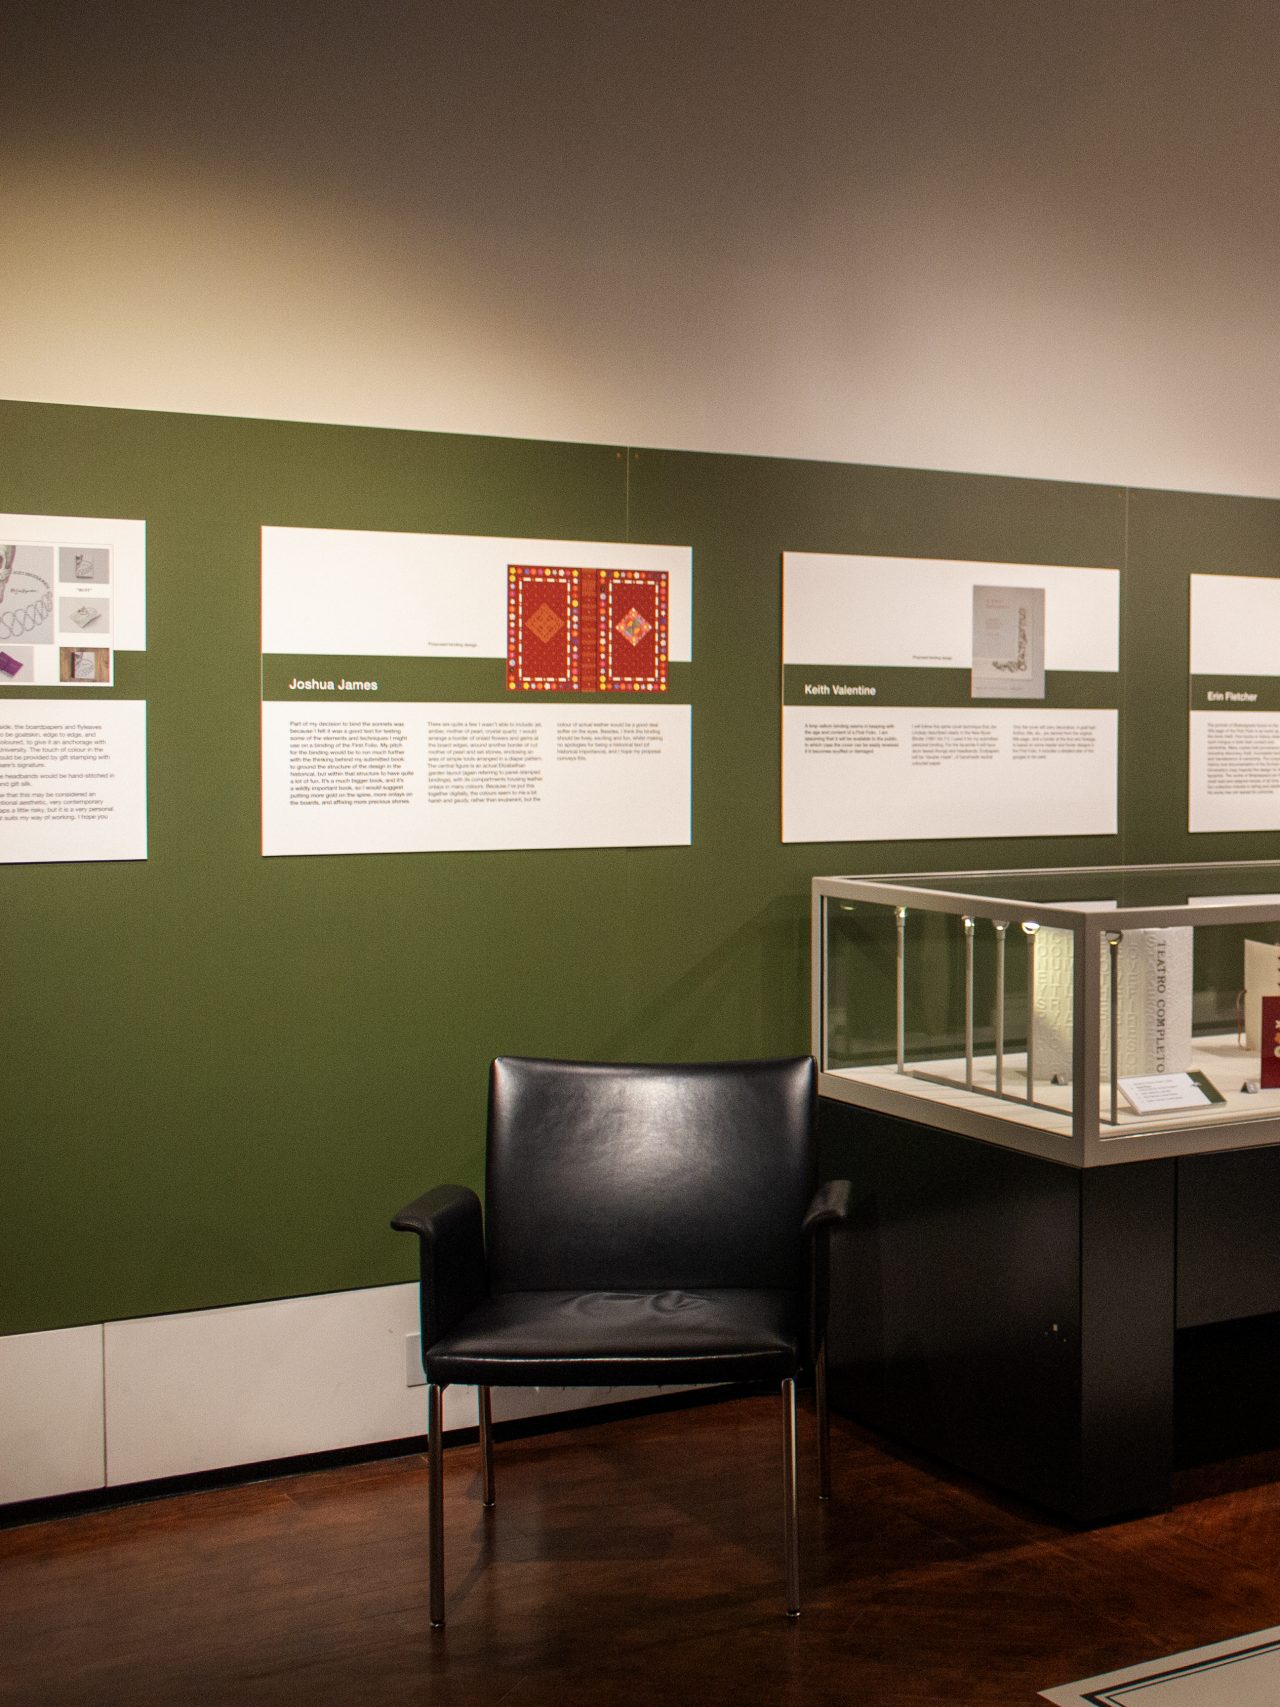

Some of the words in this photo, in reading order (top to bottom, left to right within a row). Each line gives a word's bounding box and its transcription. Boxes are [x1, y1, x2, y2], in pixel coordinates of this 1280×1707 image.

[289, 678, 335, 690] Joshua
[337, 679, 378, 691] James
[804, 684, 830, 695] Keith
[832, 684, 877, 696] Valentine
[1207, 691, 1224, 701] Erin
[1225, 692, 1257, 702] Fletcher
[1157, 940, 1166, 993] TEATRO
[1156, 999, 1166, 1073] COMPLETO
